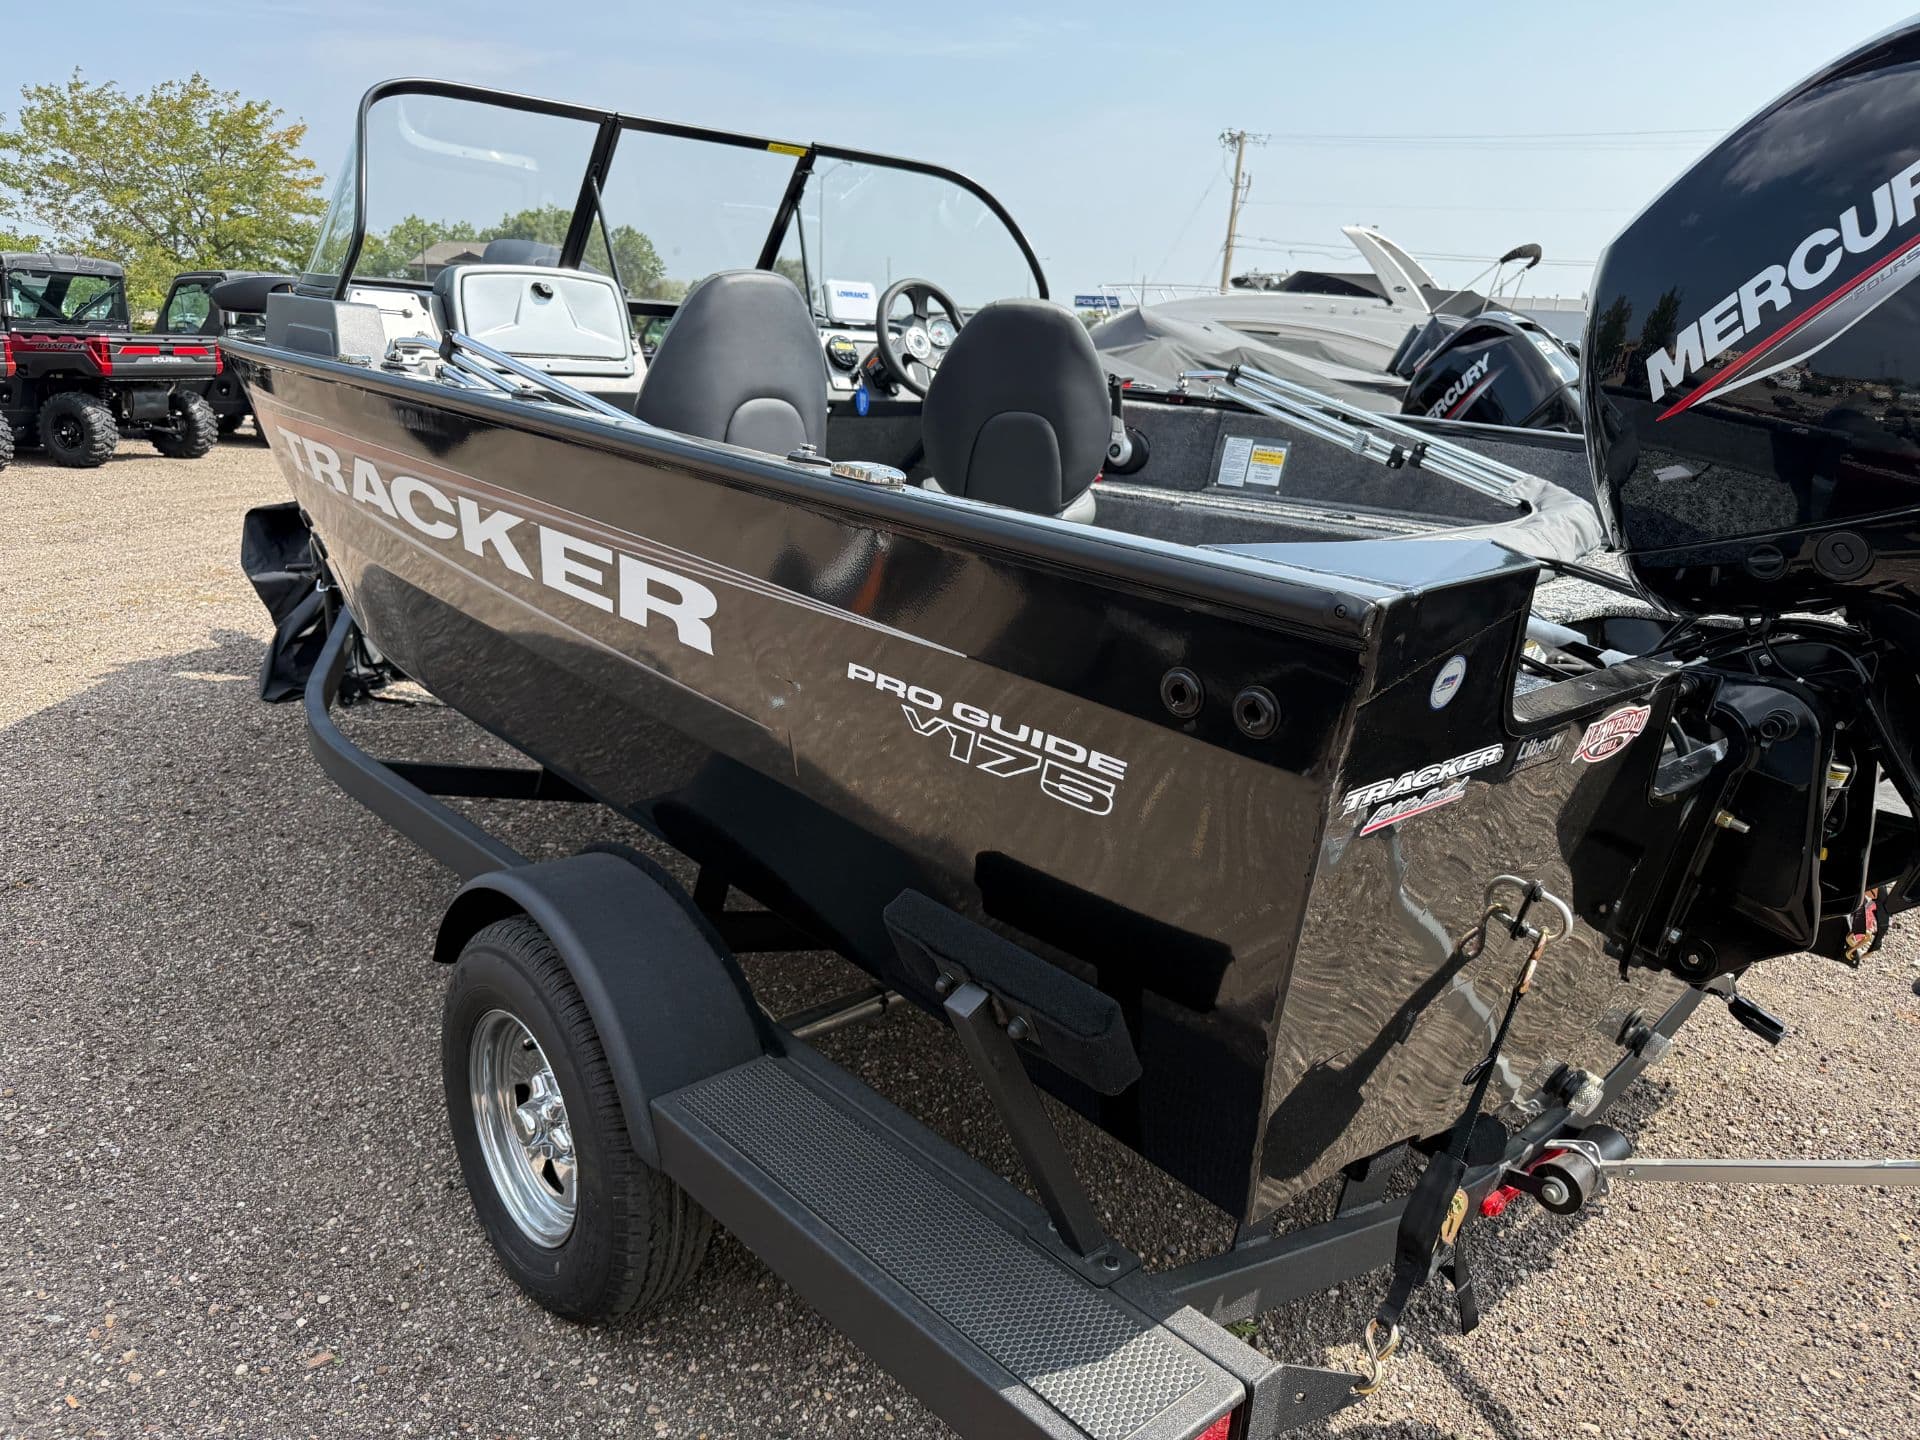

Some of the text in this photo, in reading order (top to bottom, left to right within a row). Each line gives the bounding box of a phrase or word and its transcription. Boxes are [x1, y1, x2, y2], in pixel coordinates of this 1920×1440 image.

[837, 290, 869, 299] LOWRANCE
[277, 425, 718, 656] TRACKER
[847, 662, 1129, 781] PRO GUIDE
[901, 704, 1116, 816] V175
[1516, 731, 1567, 761] Liberty
[1343, 745, 1503, 813] TRACKER
